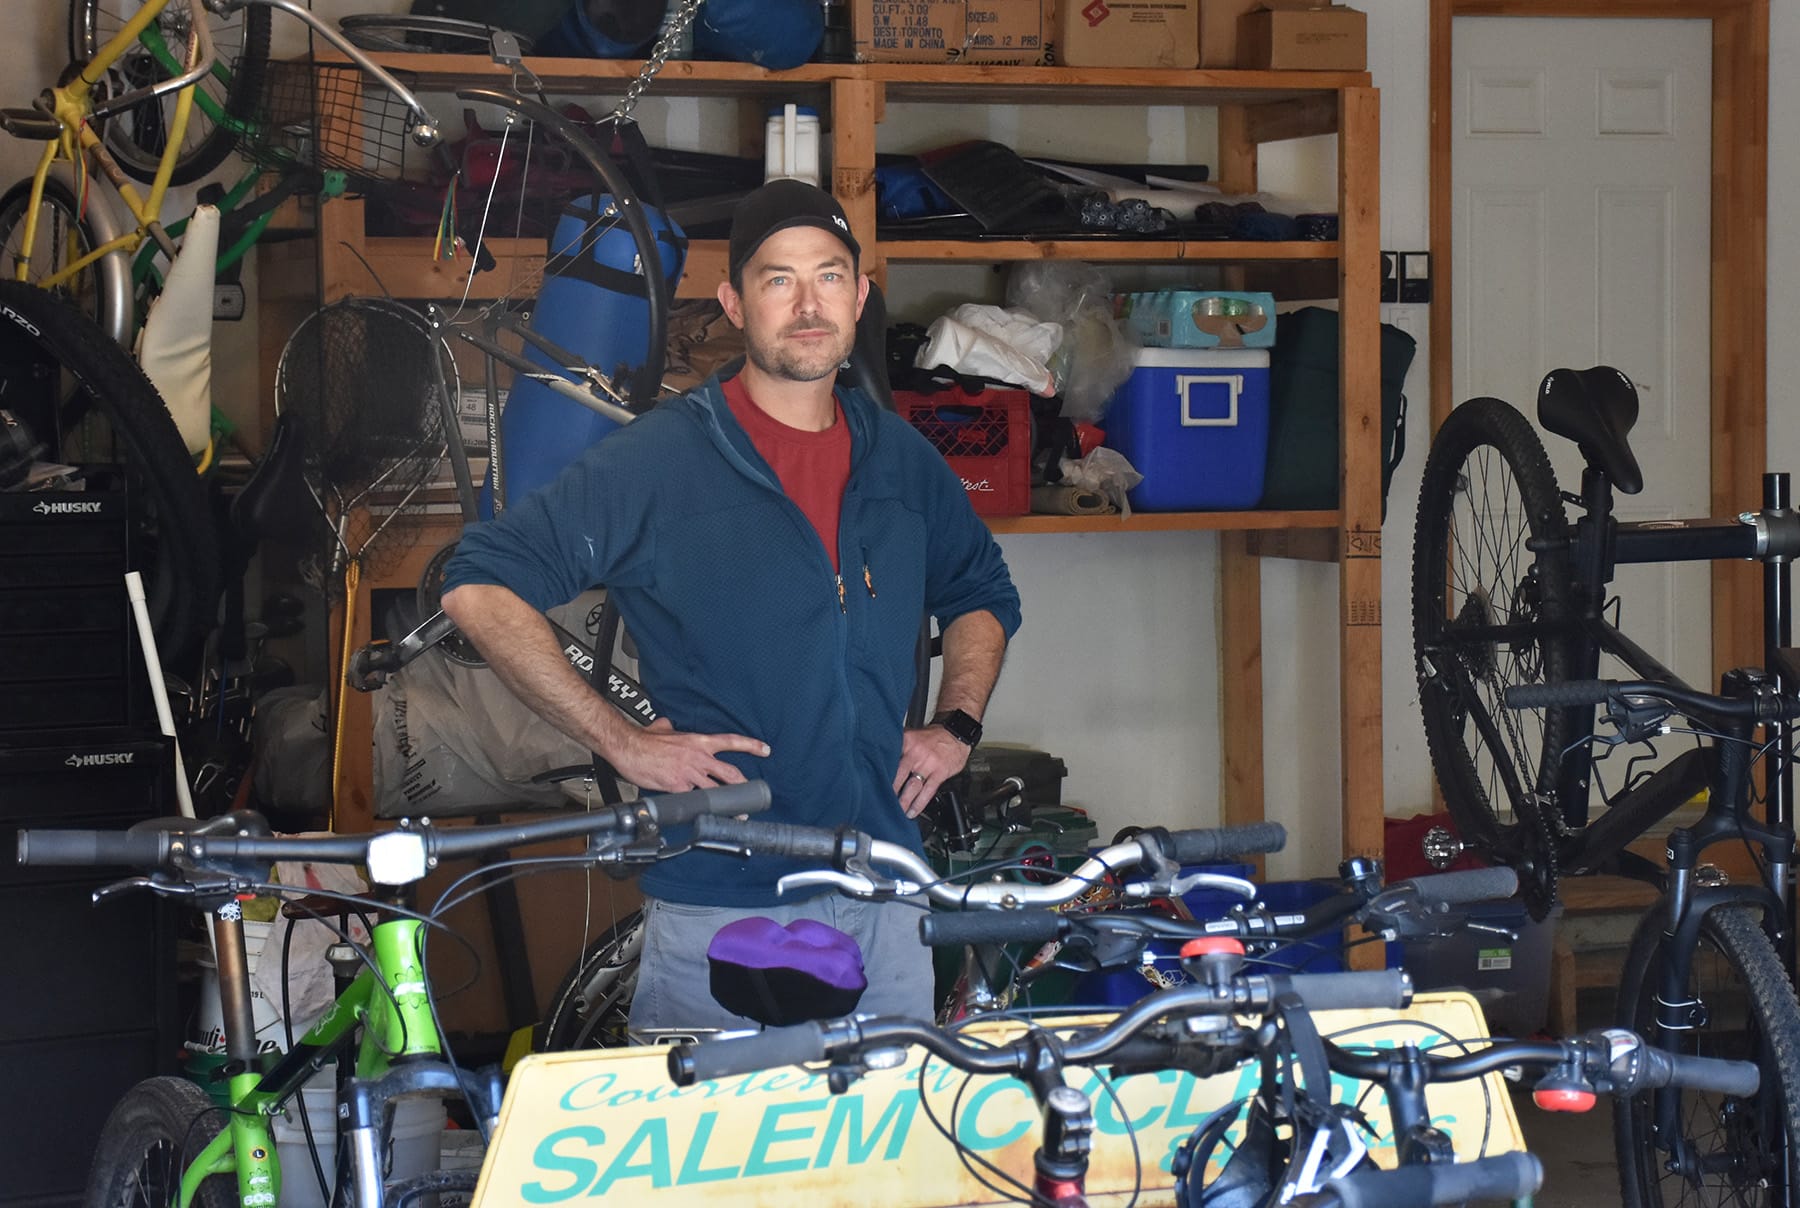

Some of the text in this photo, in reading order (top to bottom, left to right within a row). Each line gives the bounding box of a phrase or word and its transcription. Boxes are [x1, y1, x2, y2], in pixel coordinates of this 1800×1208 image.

[873, 38, 945, 48] MADE IN CHINA
[1002, 36, 1012, 46] 12
[1021, 36, 1039, 46] PRS
[0, 304, 41, 336] RZO
[488, 403, 500, 490] ROCKY MOUNTAIN
[51, 502, 101, 513] HUSKY
[83, 752, 134, 766] HUSKY
[558, 1066, 868, 1112] Courtes
[520, 1088, 923, 1206] SALEM
